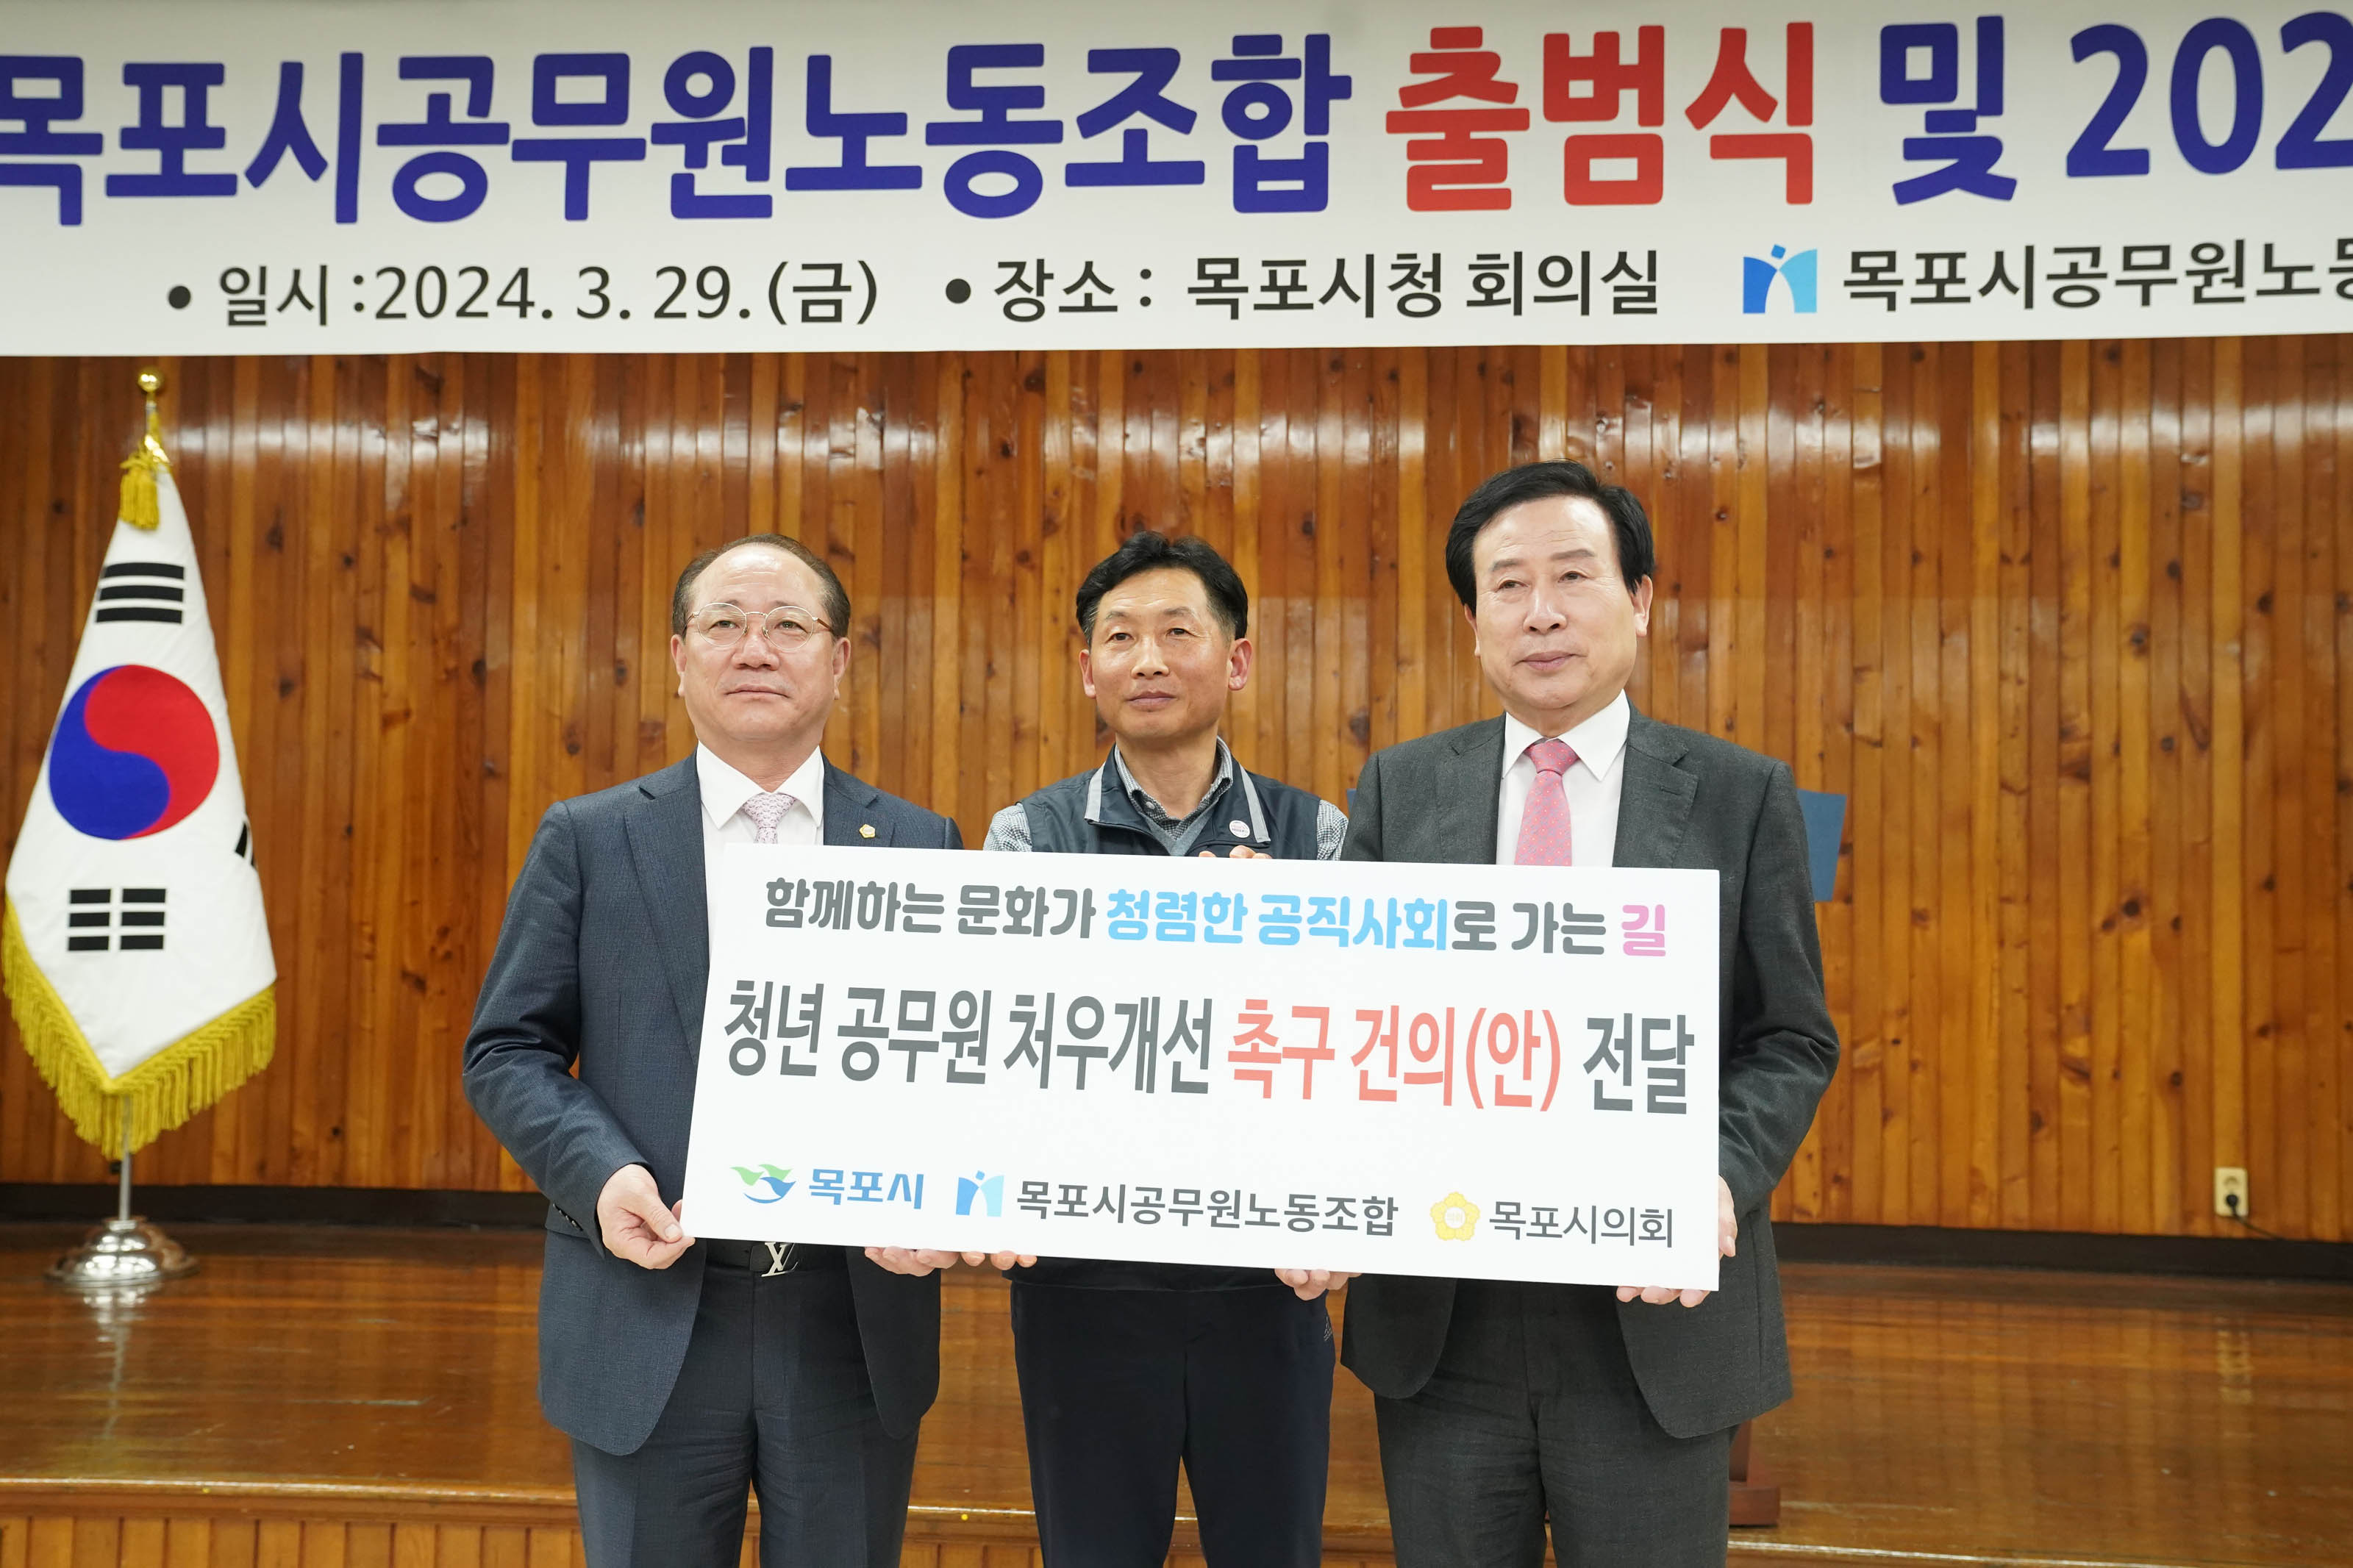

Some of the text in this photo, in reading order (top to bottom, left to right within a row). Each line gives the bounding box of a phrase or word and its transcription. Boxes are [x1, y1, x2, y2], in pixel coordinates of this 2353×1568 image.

[0, 33, 1354, 227] 목포시공무원노동조합
[1385, 21, 1815, 213] 출범식
[1879, 15, 2018, 207] 및
[220, 265, 329, 328] 일시
[1188, 252, 1443, 321] 목포시청
[1466, 250, 1659, 318] 회의실
[765, 877, 1667, 959] 함께하는 문화가 청렴한 공직사회로 가는 길
[724, 980, 1696, 1117] 청년 공무원 처우개선 촉구 건의(안) 전달
[808, 1168, 926, 1211] 목포시
[1016, 1181, 1401, 1238] 목포시공무원노동조합
[1489, 1200, 1674, 1250] 목포시의회
